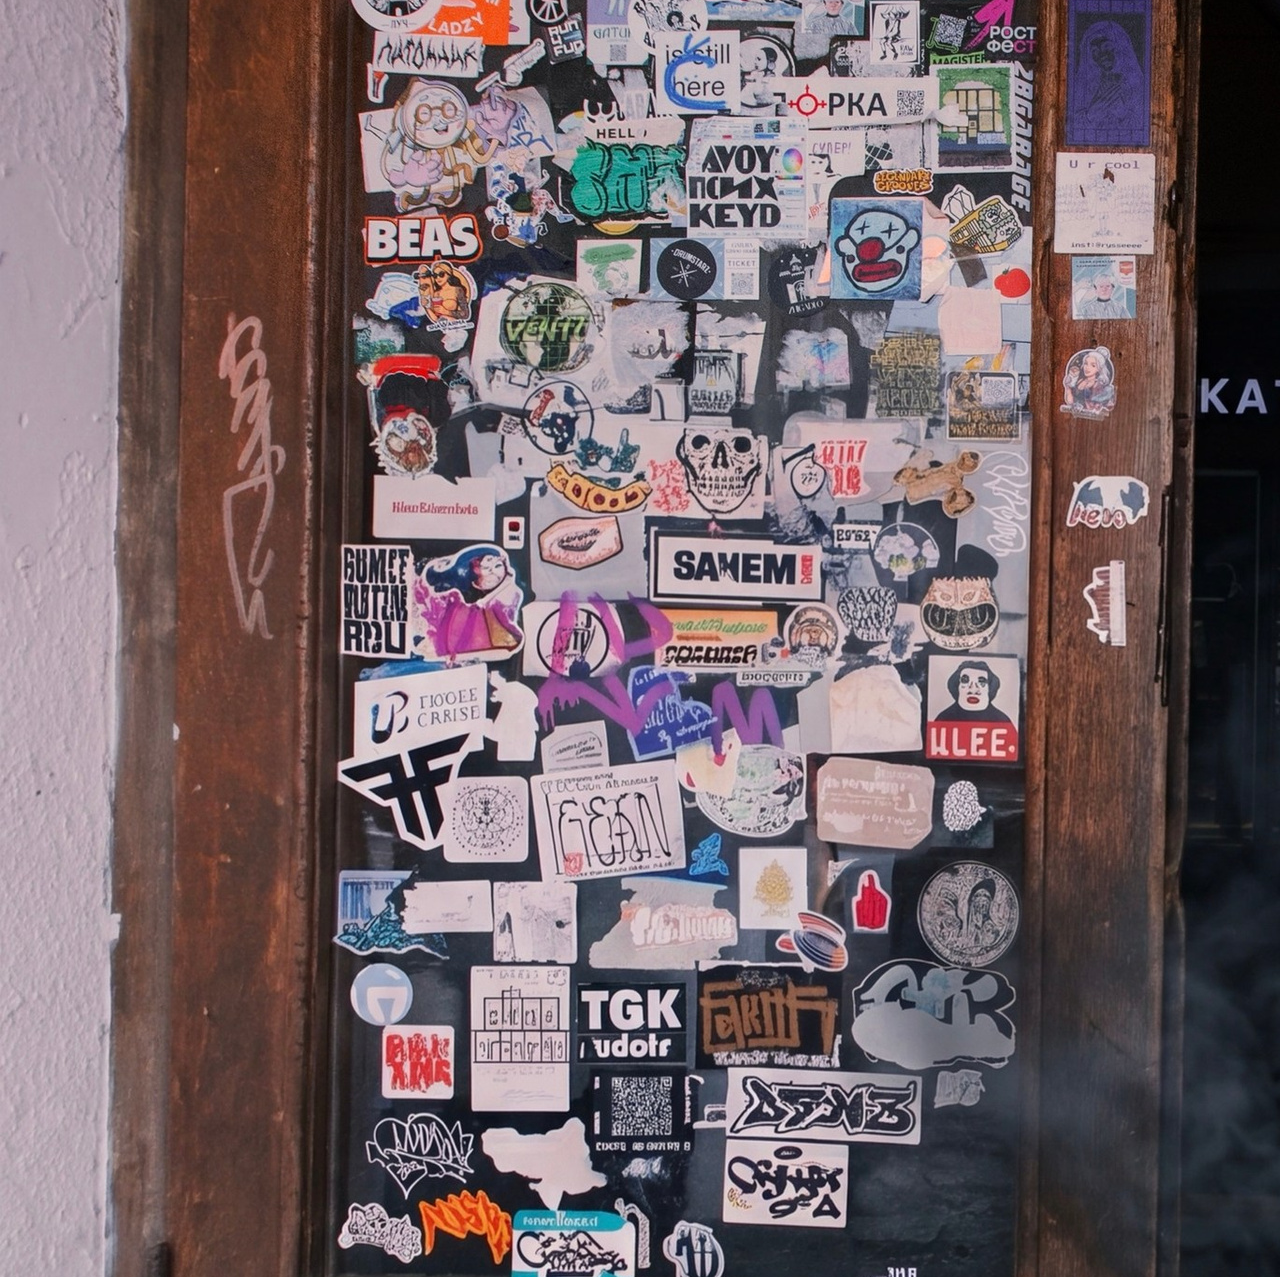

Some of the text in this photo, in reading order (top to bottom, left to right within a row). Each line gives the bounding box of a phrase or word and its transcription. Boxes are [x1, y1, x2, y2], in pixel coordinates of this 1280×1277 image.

[990, 26, 1037, 39] РОСТ
[693, 43, 731, 65] still
[673, 72, 725, 97] here
[812, 141, 851, 155] СУПЕР!
[1069, 160, 1078, 169] U
[1104, 160, 1141, 169] cool
[874, 168, 932, 182] LEGENDARY
[688, 175, 780, 201] ПСИХ
[875, 179, 932, 193] GROOVES
[690, 203, 782, 228] KEYD
[367, 218, 479, 259] BEAS
[727, 260, 756, 268] TICKET
[580, 989, 682, 1032] TGK
